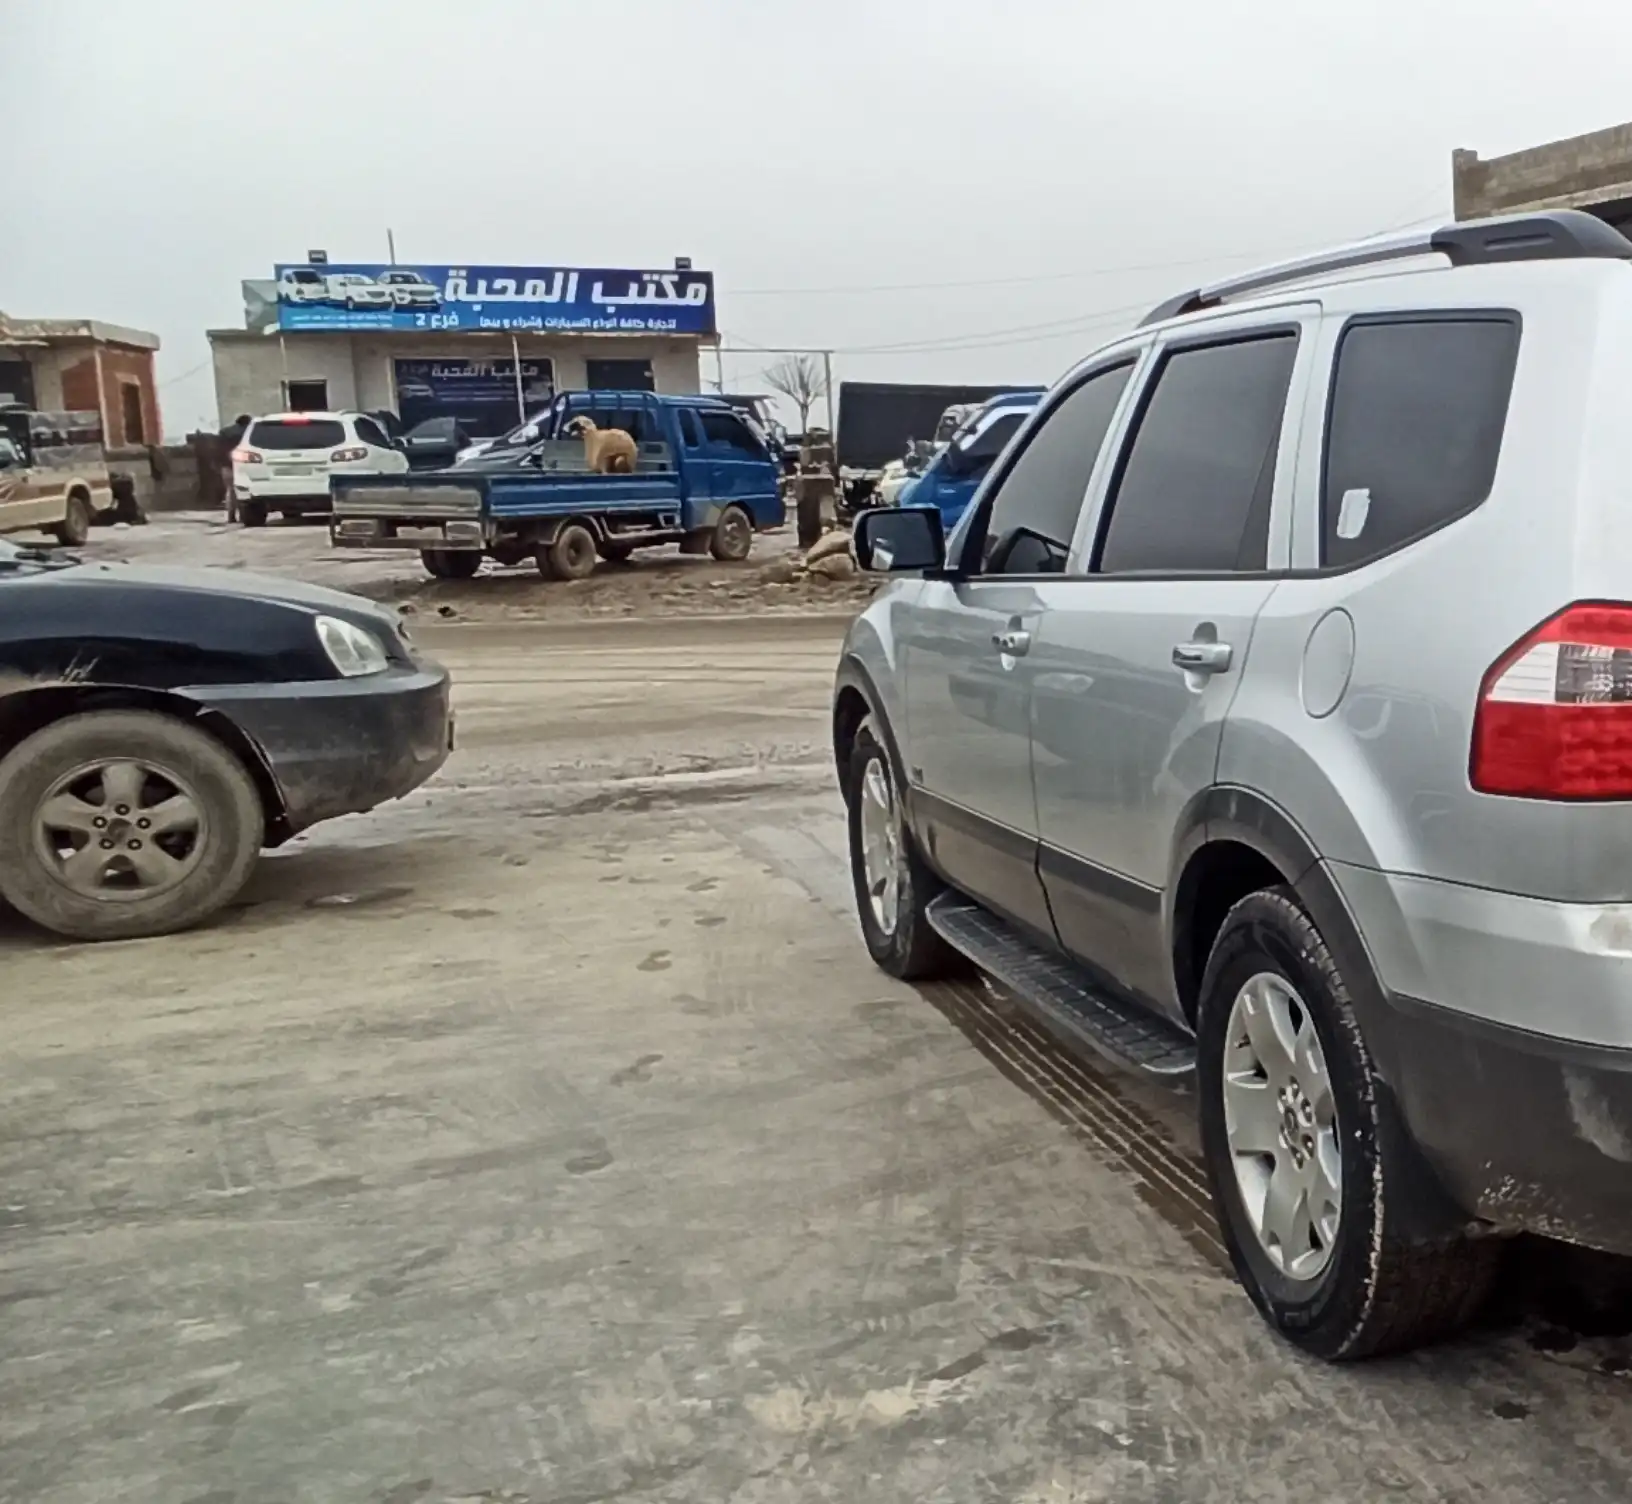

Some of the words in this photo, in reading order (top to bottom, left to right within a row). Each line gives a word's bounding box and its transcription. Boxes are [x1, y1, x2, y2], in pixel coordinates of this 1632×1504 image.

[444, 269, 580, 312] المحبة
[592, 273, 707, 313] مكتب
[415, 313, 426, 326] 2
[431, 311, 459, 328] فرع
